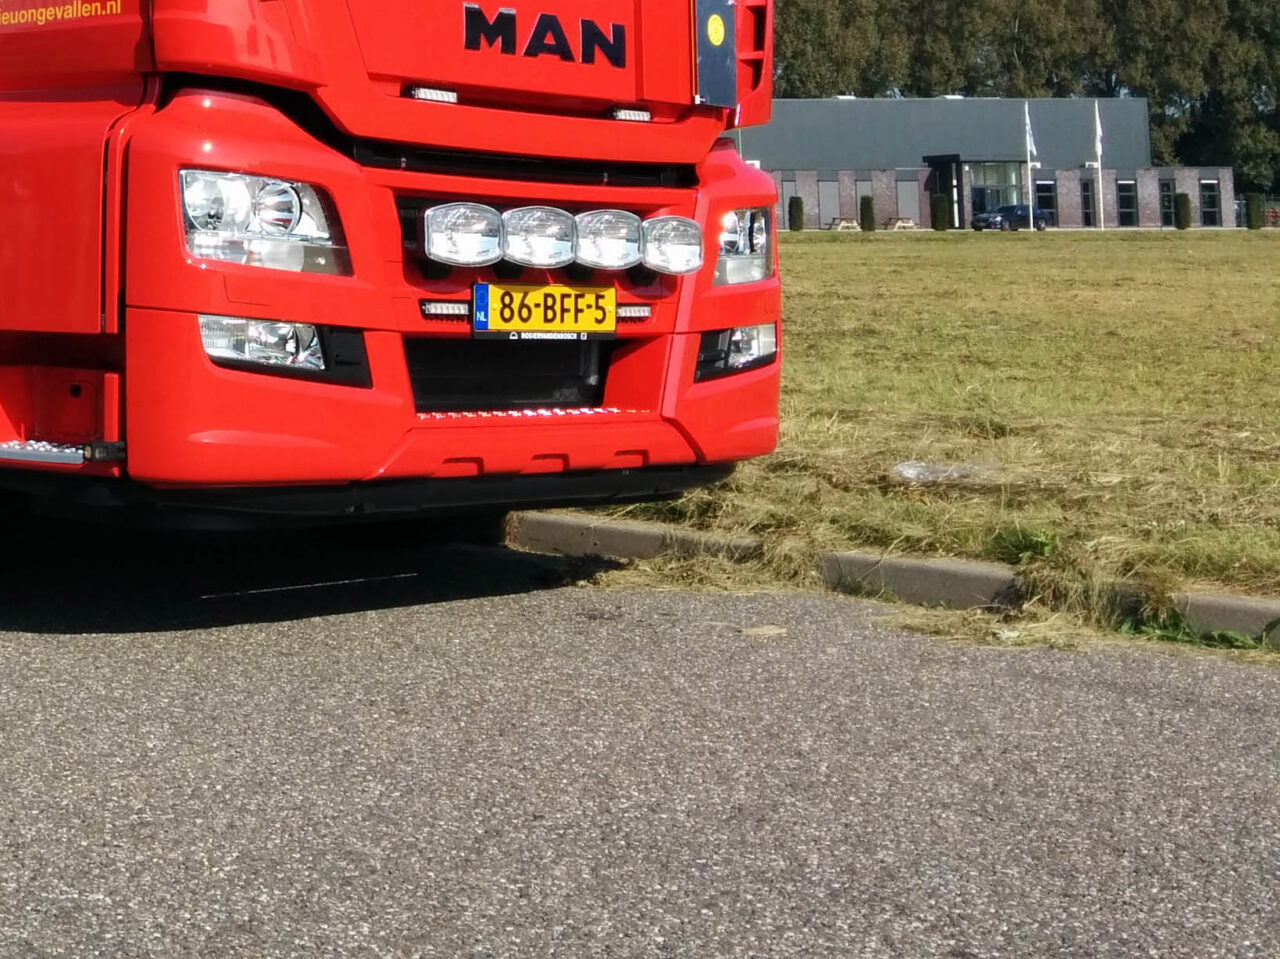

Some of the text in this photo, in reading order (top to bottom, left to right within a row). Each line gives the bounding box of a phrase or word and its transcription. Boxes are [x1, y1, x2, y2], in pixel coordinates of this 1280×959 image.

[463, 2, 626, 69] MAN
[476, 311, 487, 322] NL
[500, 290, 607, 325] 86-BFF-5
